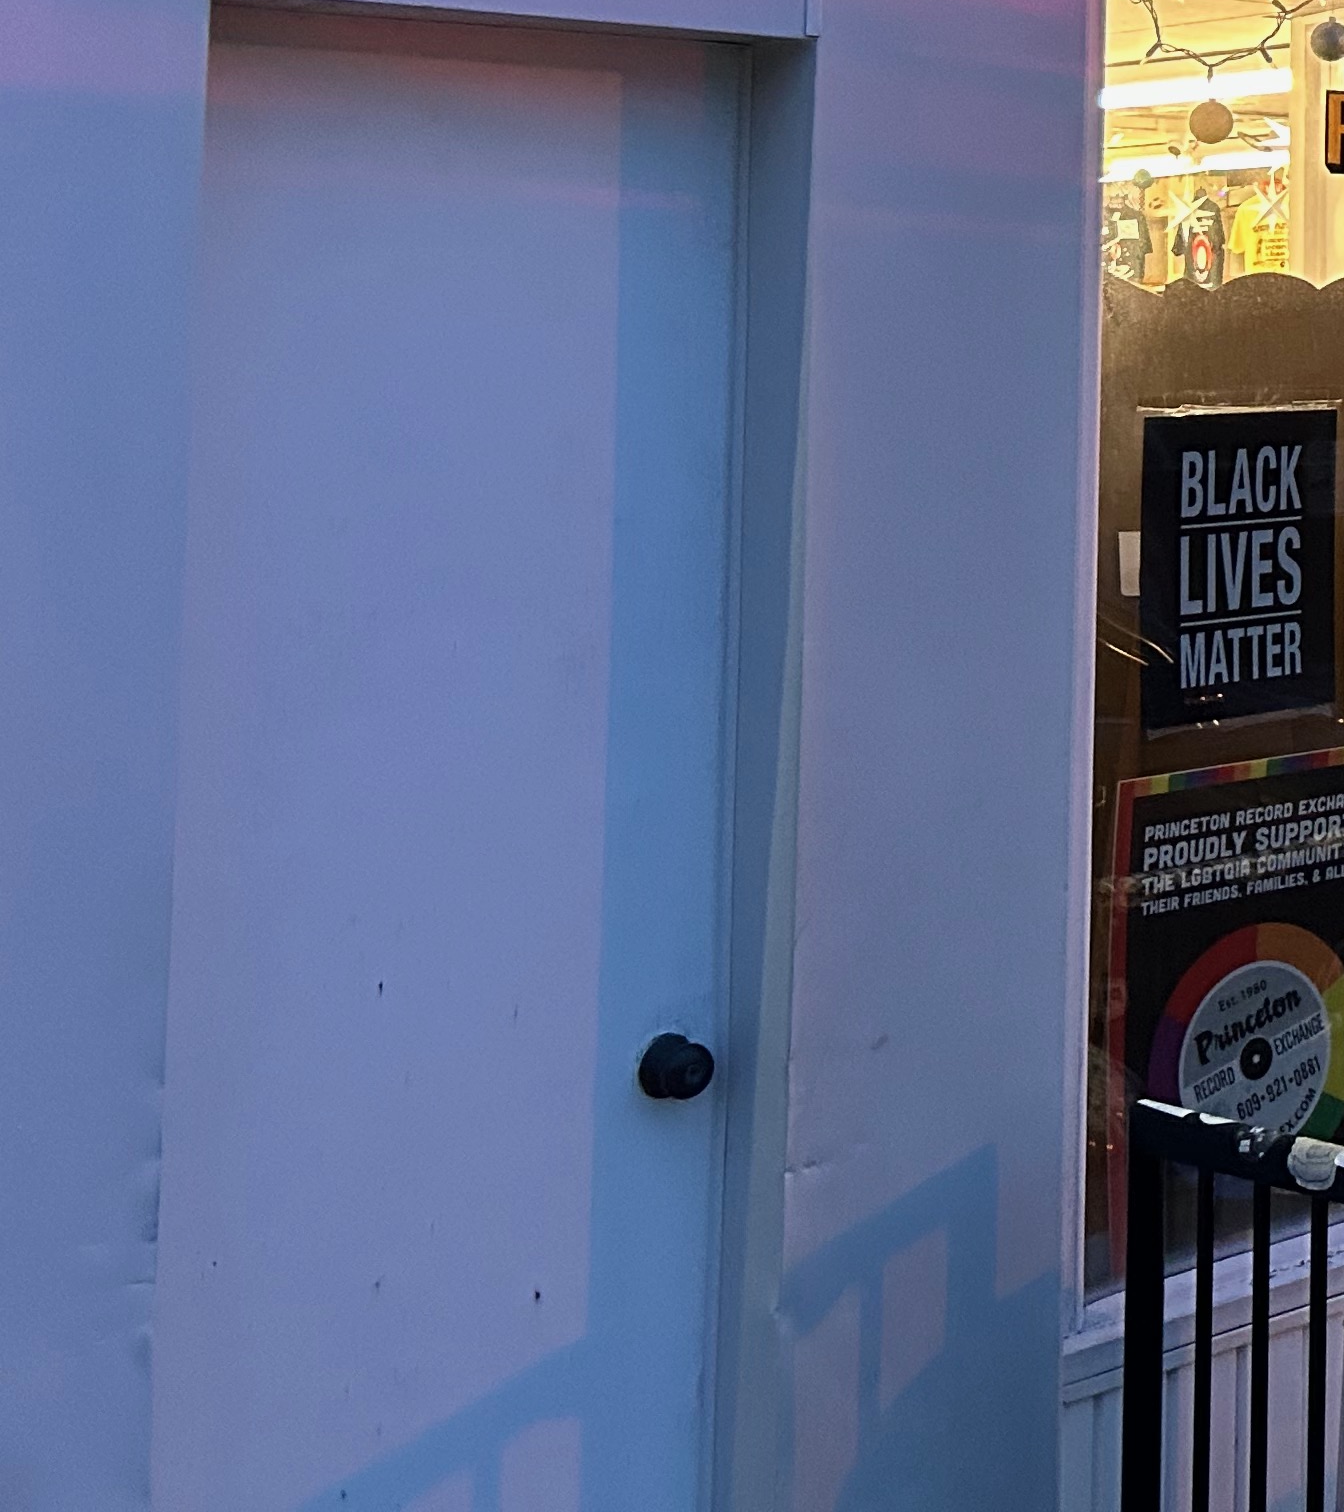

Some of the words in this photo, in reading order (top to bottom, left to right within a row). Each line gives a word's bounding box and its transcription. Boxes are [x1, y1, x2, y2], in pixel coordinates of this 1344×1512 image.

[1180, 445, 1302, 518] BLACK
[1180, 525, 1302, 616] LIVES
[1180, 622, 1302, 689] MATTER
[1143, 833, 1244, 871] PROUDLY
[1145, 813, 1230, 842] PRINCETON
[1236, 803, 1293, 827] RECORD
[1141, 896, 1180, 916] THEIR
[1312, 869, 1321, 883] &
[1142, 874, 1175, 895] THE
[1193, 1068, 1236, 1102] RECORD
[1274, 1014, 1325, 1055] EXCHANGE
[1194, 988, 1301, 1065] Princeton
